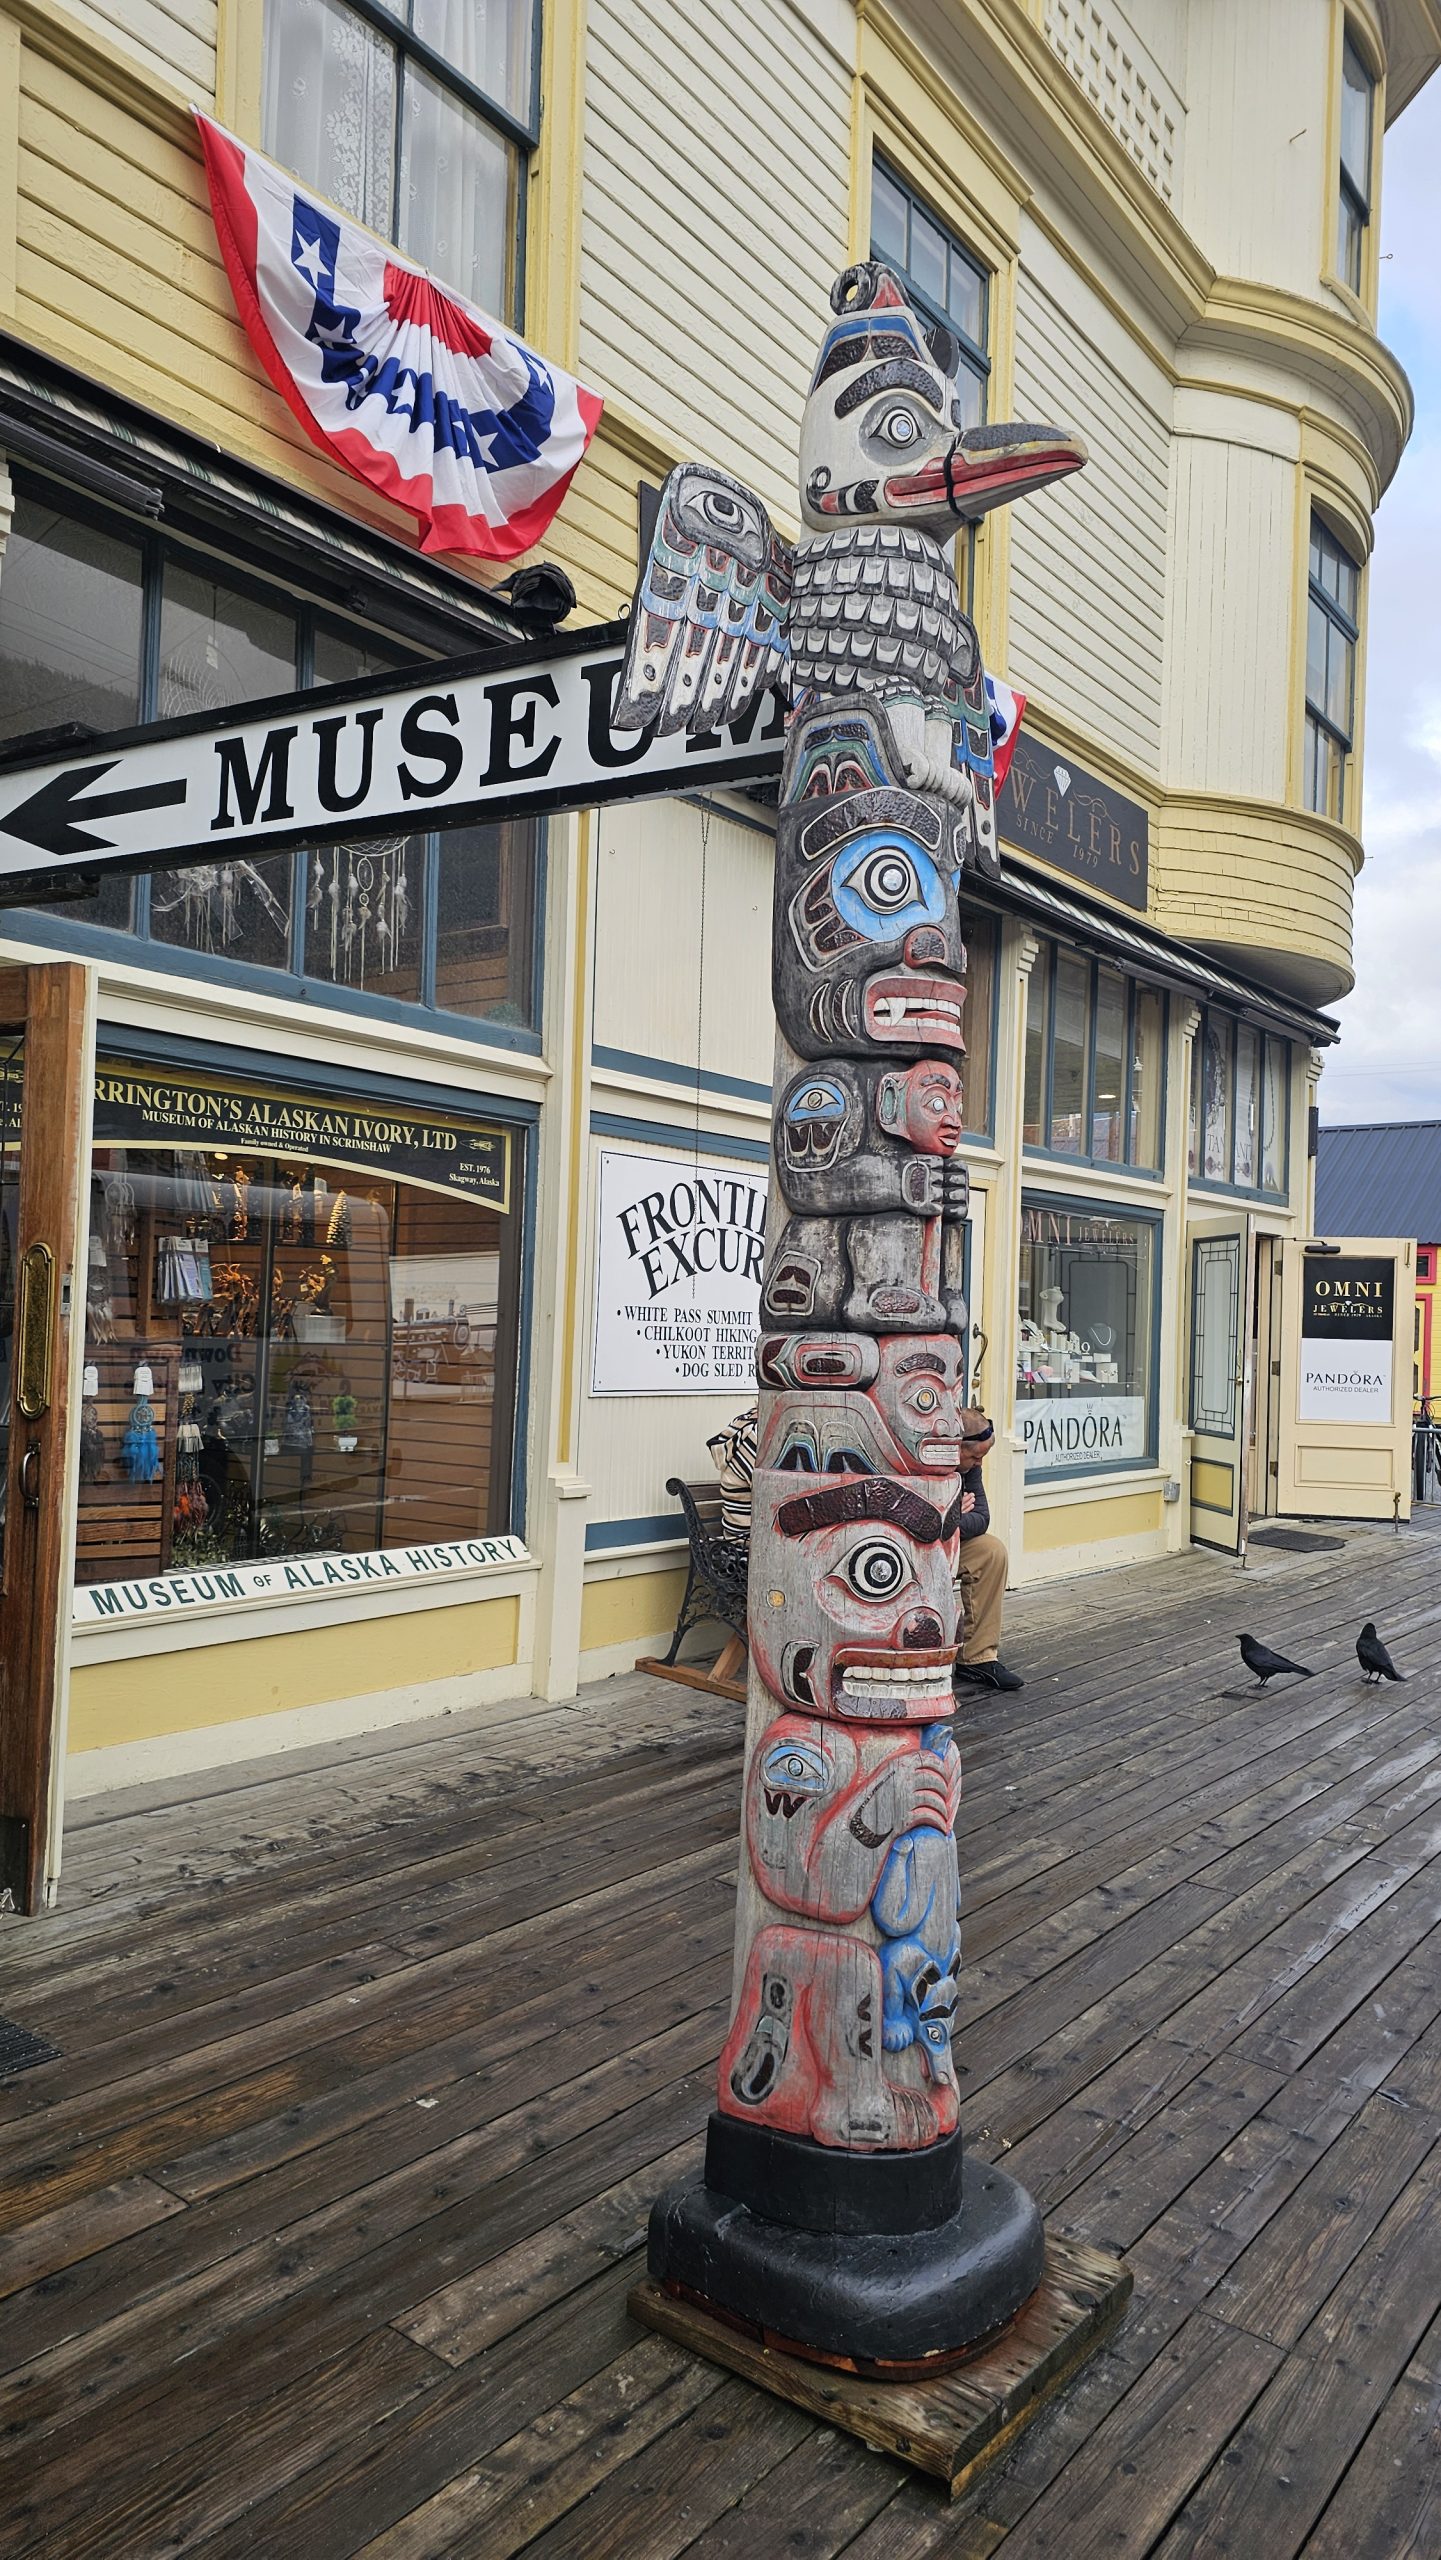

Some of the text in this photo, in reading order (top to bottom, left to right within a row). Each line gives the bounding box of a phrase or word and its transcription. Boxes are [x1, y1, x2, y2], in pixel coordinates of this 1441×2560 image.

[1016, 815, 1098, 868] SINCE 1979
[142, 1109, 391, 1154] MUSEUM OF ALASKAN HISTORY IN SCRIMSHAW
[247, 1103, 349, 1136] ALASKAN
[353, 1119, 418, 1149] IVORY,
[422, 1129, 457, 1151] LTD
[240, 1137, 260, 1147] Family
[260, 1141, 278, 1149] owned
[284, 1143, 309, 1153] Operated
[460, 1163, 491, 1175] EST. 1976
[449, 1173, 500, 1187] Skagway, Alaska
[1020, 1209, 1072, 1246] MNI
[1315, 1280, 1383, 1298] OMNI
[624, 1305, 753, 1325] WHITE PASS SUMMIT
[1313, 1304, 1383, 1314] JEWELERS
[644, 1326, 757, 1343] CHILKOOT HIKING
[663, 1344, 706, 1360] YUKON
[682, 1363, 709, 1378] DOG
[714, 1363, 743, 1378] SLED
[1306, 1372, 1383, 1386] PANDORA
[1024, 1415, 1123, 1454] PANDORA
[89, 1572, 247, 1615] MUSEUM
[253, 1574, 272, 1587] OF
[283, 1554, 401, 1590] ALASKA
[407, 1539, 517, 1571] HISTORY
